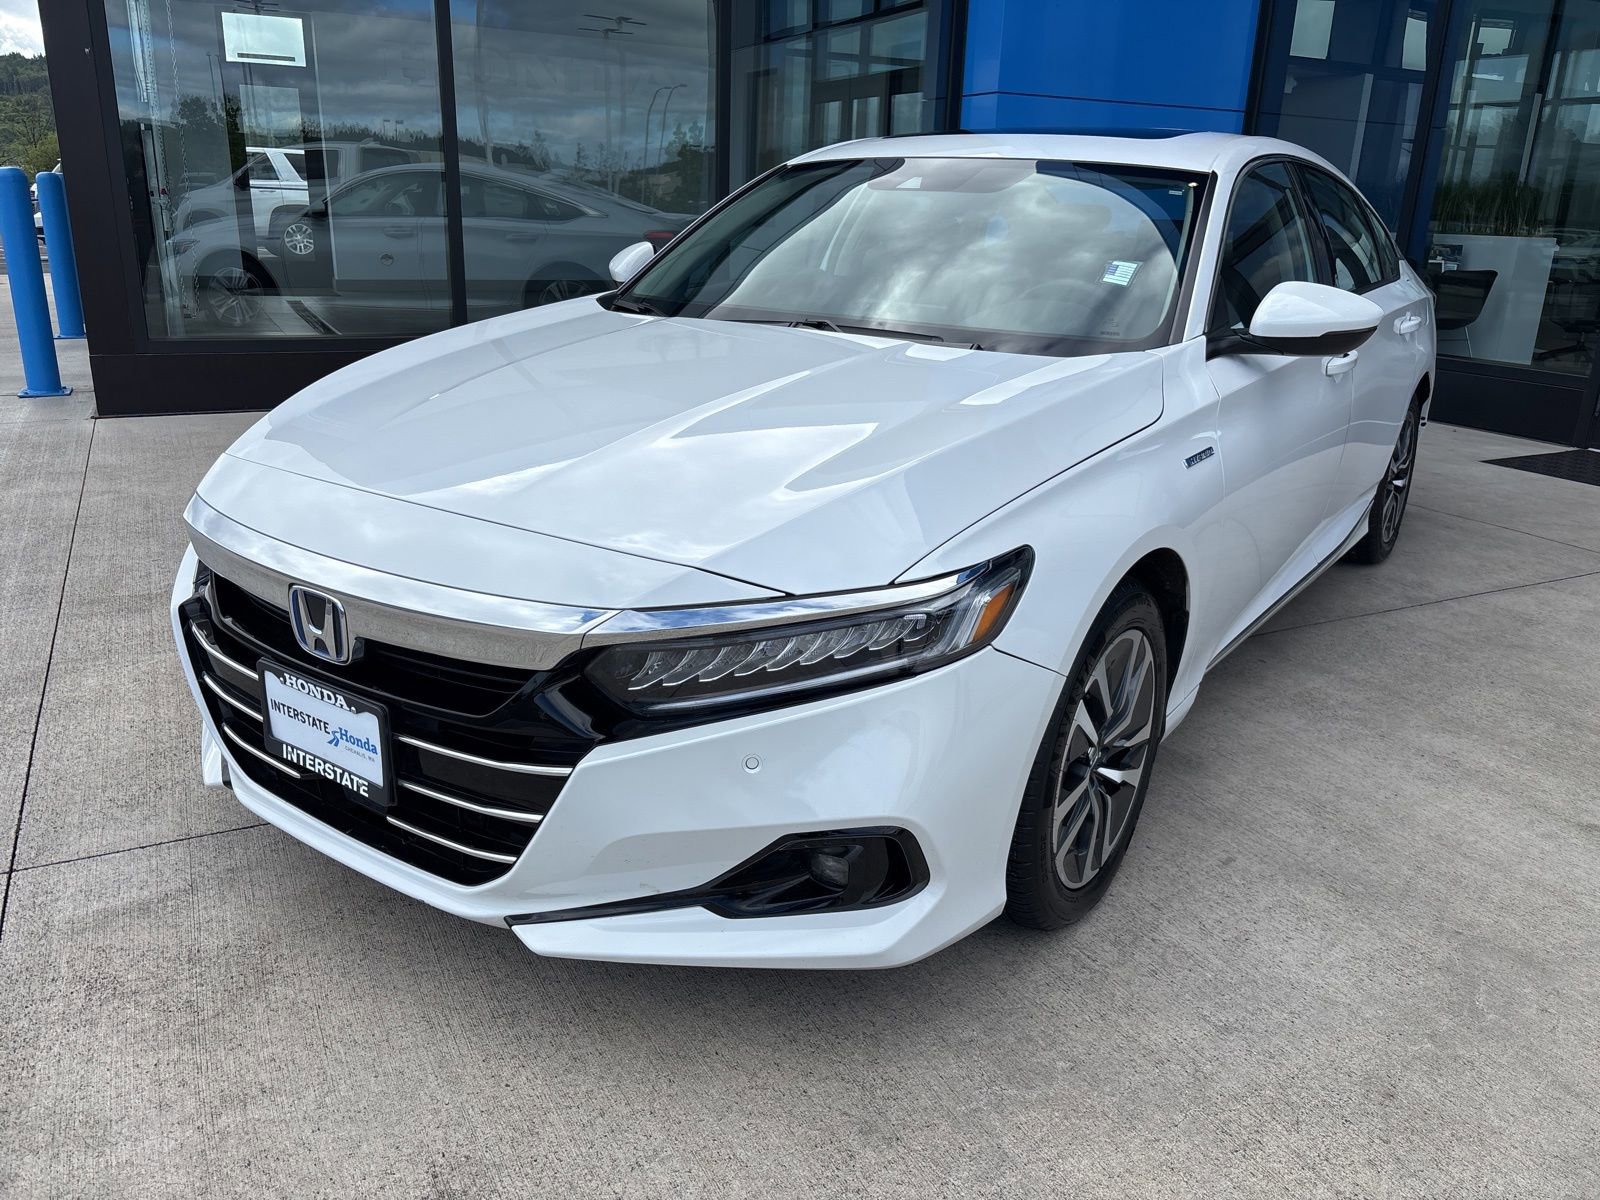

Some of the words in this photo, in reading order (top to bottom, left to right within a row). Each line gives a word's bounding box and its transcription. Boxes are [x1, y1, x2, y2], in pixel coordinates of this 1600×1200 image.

[284, 673, 350, 711] HONDA
[270, 698, 331, 735] INTERSTATE
[337, 727, 378, 755] Honda
[282, 743, 369, 798] INTERSTATE
